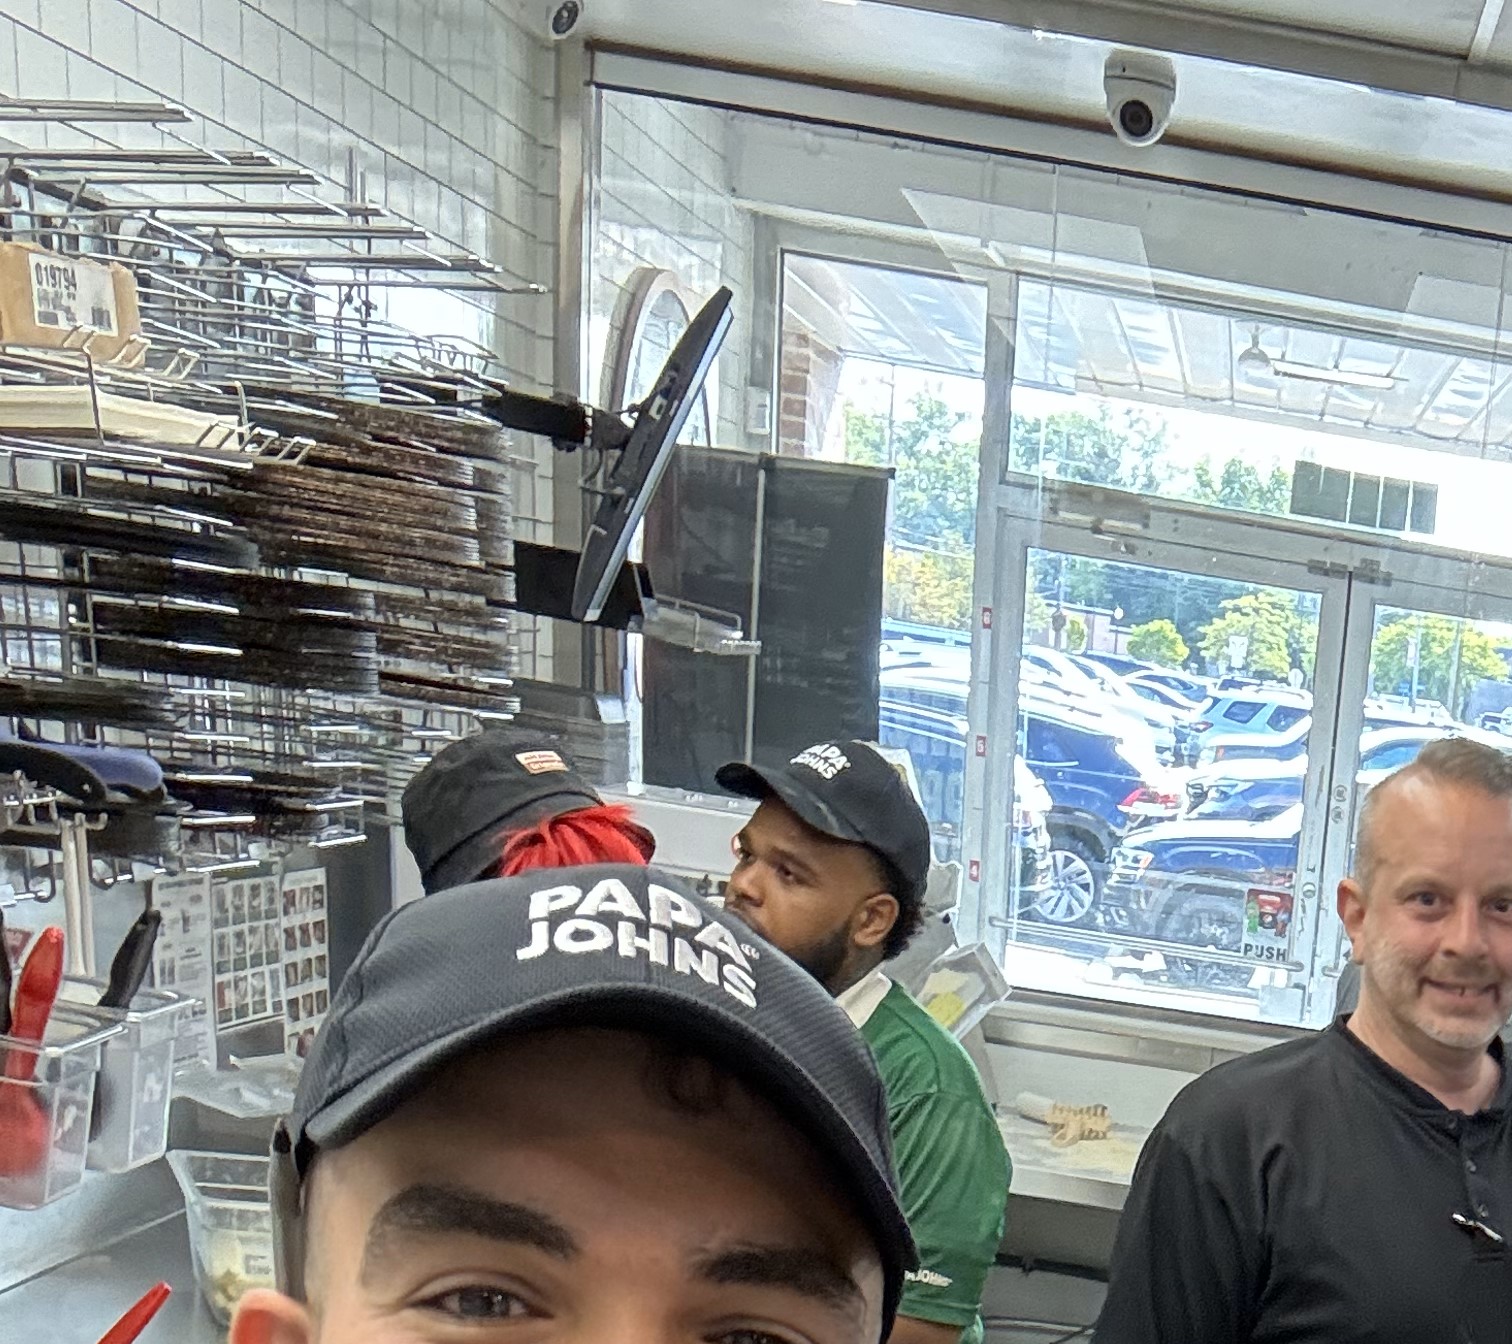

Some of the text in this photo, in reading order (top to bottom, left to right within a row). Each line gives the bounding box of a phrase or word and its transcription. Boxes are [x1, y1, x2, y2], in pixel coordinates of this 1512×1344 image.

[515, 917, 758, 1009] JOHNS
[528, 878, 754, 972] PAPA
[1243, 943, 1288, 962] PUSH
